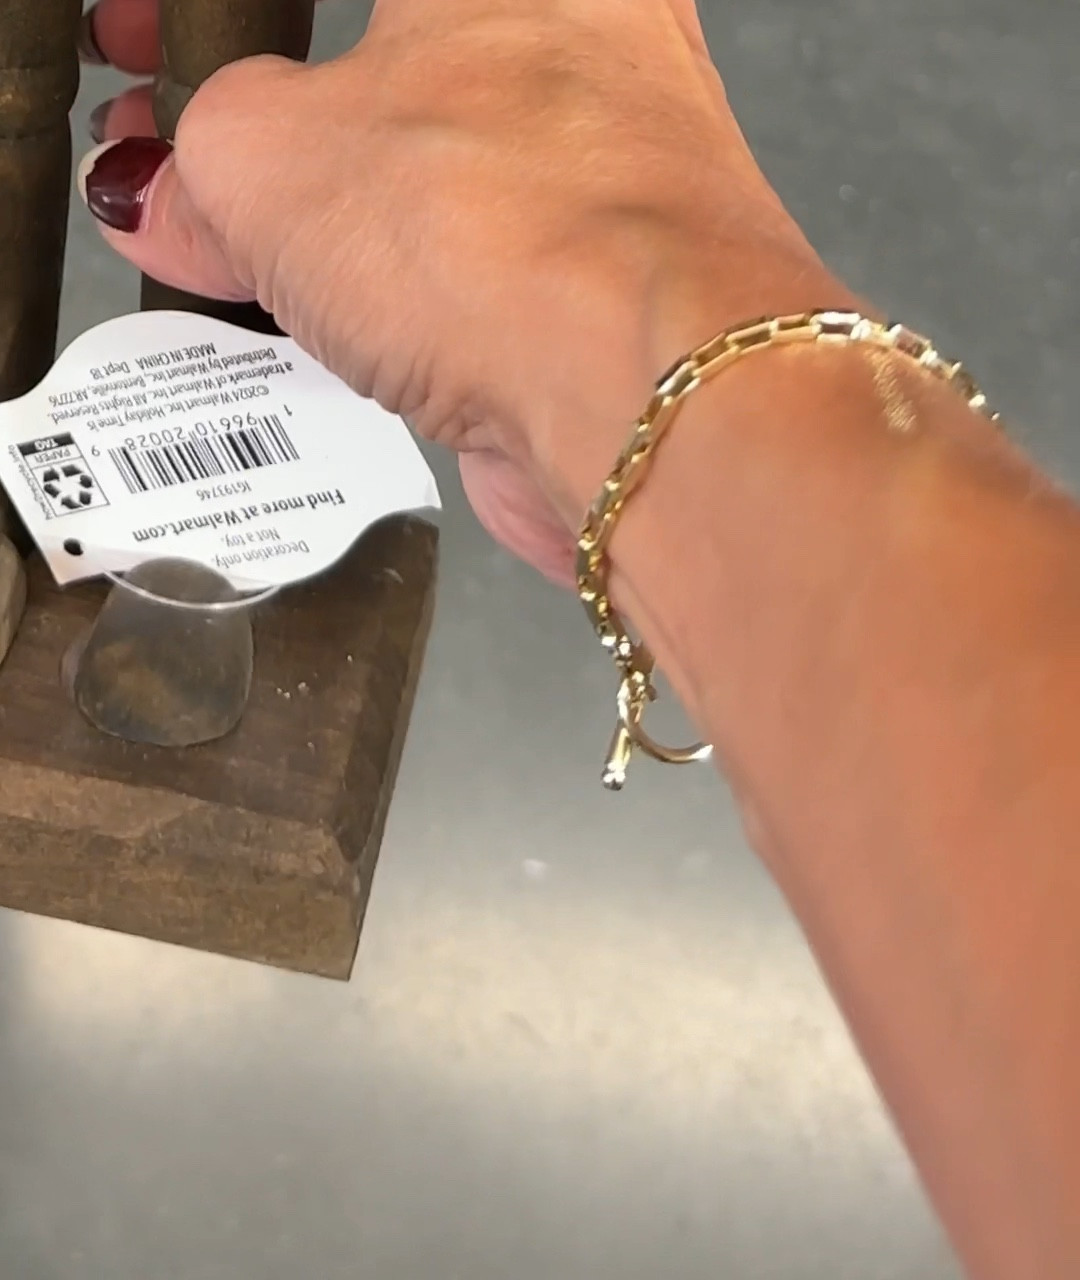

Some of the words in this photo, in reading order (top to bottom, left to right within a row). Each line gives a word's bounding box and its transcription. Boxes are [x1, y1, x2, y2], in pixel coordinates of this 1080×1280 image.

[170, 348, 185, 362] IN
[183, 342, 217, 361] MADE
[221, 346, 277, 370] Distributed
[102, 360, 131, 376] Dept
[134, 352, 171, 371] CHINA
[208, 356, 223, 371] by
[284, 361, 294, 371] a
[166, 362, 210, 380] Walmart
[226, 363, 286, 385] trademark
[168, 378, 217, 397] Walmart
[216, 375, 227, 388] of
[99, 394, 134, 411] Rights
[185, 390, 233, 410] Walmart
[98, 415, 127, 428] Time
[125, 405, 166, 423] Holiday
[86, 420, 100, 432] is
[194, 411, 257, 436] 96610
[34, 437, 58, 451] TAG
[124, 426, 187, 451] 20028
[34, 447, 72, 463] PAPER
[91, 444, 101, 457] 9
[263, 494, 305, 514] more
[307, 489, 346, 510] Find
[242, 505, 260, 521] at
[131, 510, 242, 542] Walmart.com
[256, 527, 281, 541] Not
[220, 534, 246, 548] toy.
[247, 532, 255, 542] a
[244, 539, 310, 562] Decoration
[210, 551, 243, 569] only.
